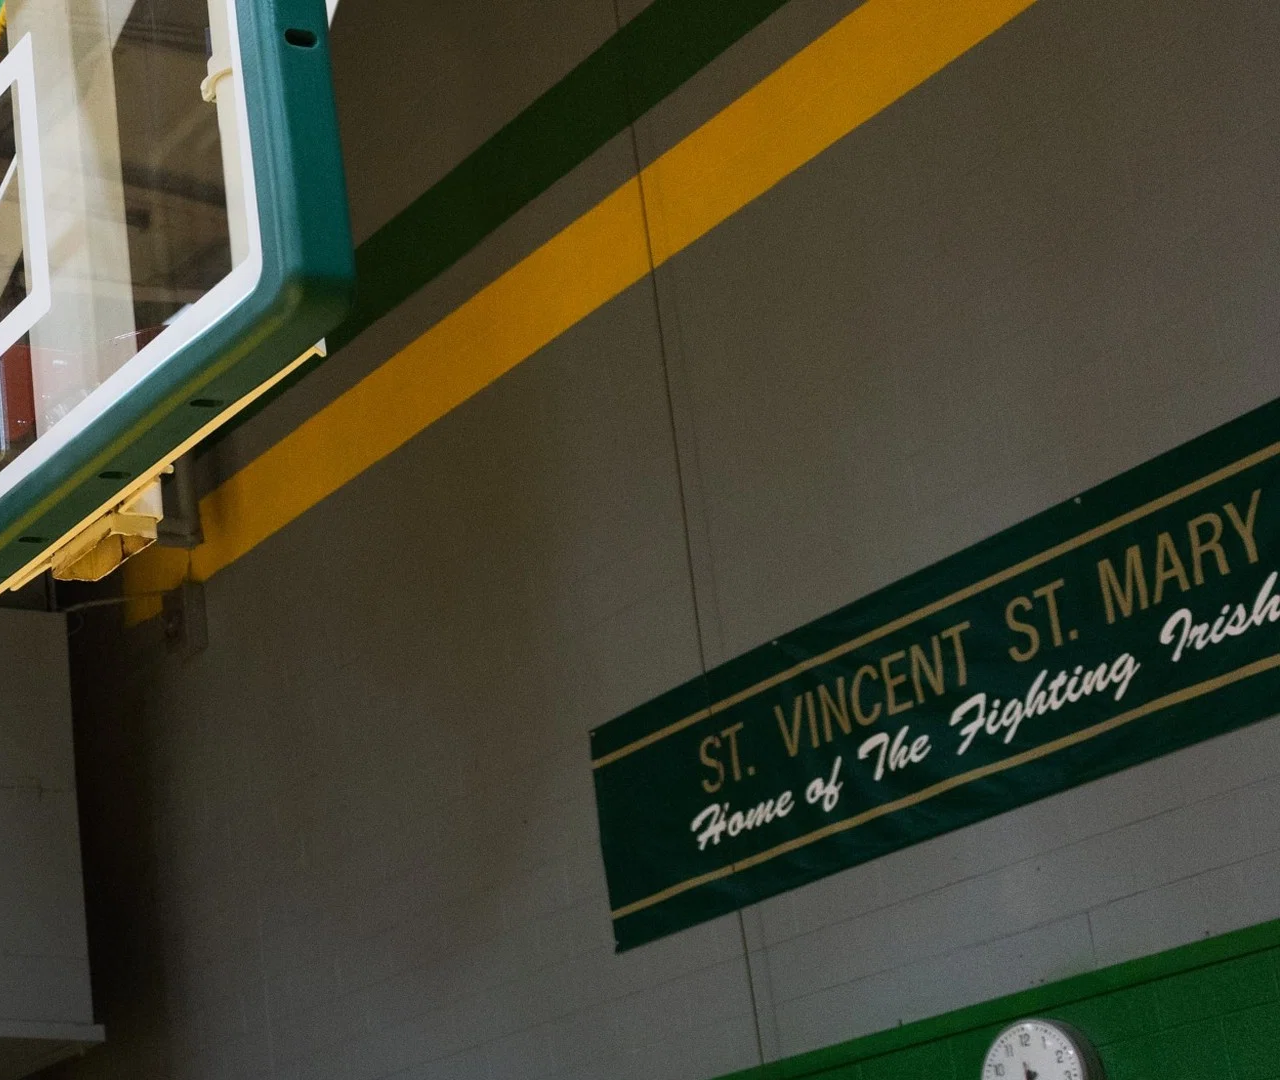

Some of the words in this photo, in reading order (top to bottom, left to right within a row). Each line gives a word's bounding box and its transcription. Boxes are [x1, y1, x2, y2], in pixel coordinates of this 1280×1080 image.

[698, 721, 757, 794] ST.
[773, 620, 972, 757] VINCENT
[1004, 577, 1079, 664] ST.
[1096, 488, 1263, 624] MARY
[689, 789, 795, 851] Home
[805, 756, 844, 813] of
[857, 725, 933, 782] The
[948, 652, 1142, 755] Fighting
[1157, 570, 1280, 662] Irish
[1018, 1032, 1031, 1047] 12
[1041, 1036, 1047, 1049] 1
[1004, 1043, 1014, 1058] 11
[1056, 1050, 1064, 1064] 2
[992, 1063, 1006, 1077] 10
